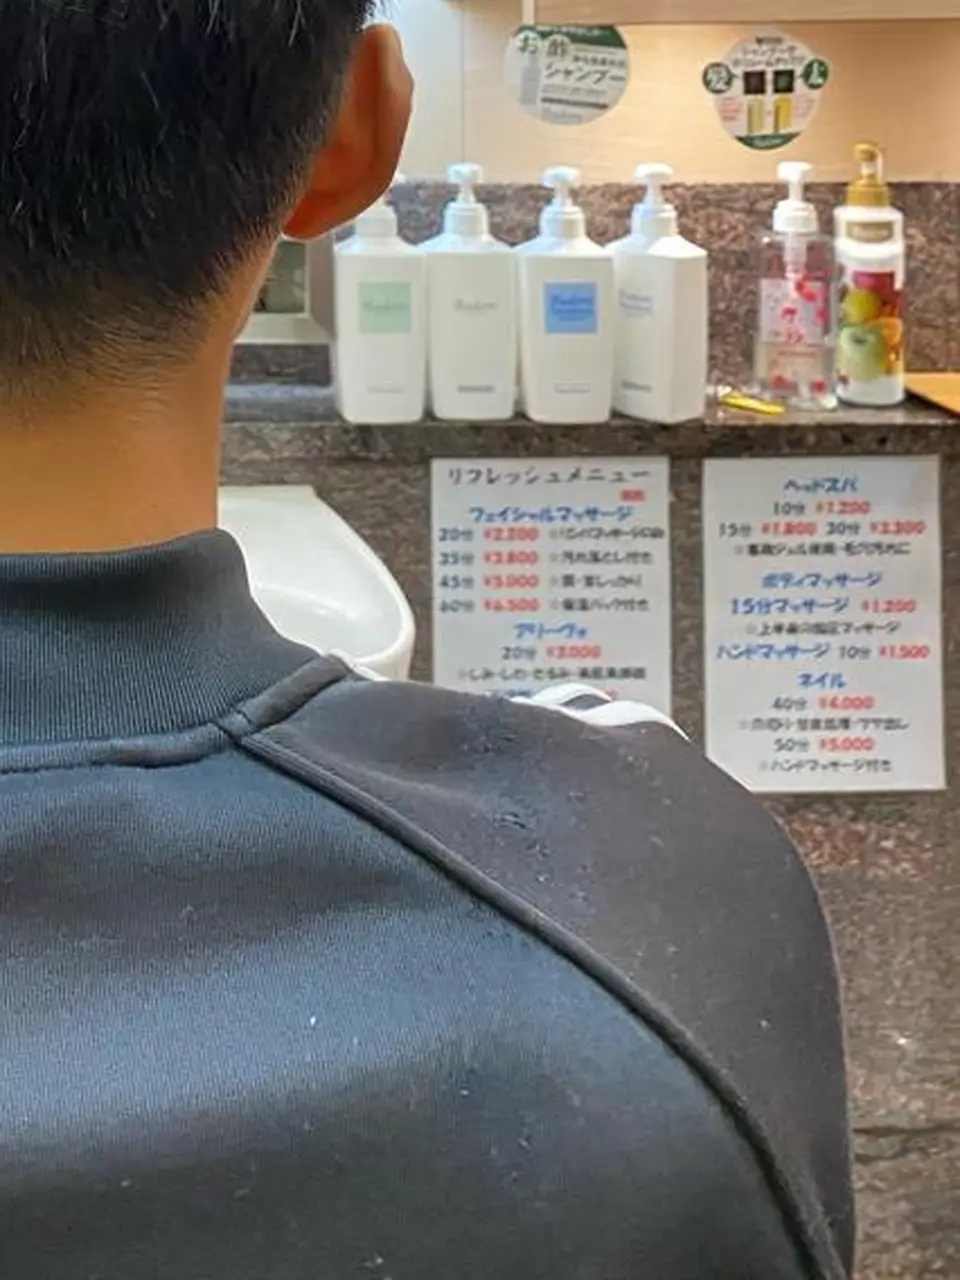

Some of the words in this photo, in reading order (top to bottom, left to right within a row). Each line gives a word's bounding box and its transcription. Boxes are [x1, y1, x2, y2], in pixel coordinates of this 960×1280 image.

[545, 61, 627, 85] シャンプー
[448, 467, 651, 486] リフレッシュメニュー
[783, 476, 859, 495] ヘッドスパ
[469, 505, 634, 523] フェイシャルマッサージ
[762, 572, 883, 589] ボディマッサージ
[730, 595, 849, 615] 15分マッサージ
[716, 641, 831, 660] ハンドマッサージ
[798, 671, 848, 689] ネイル
